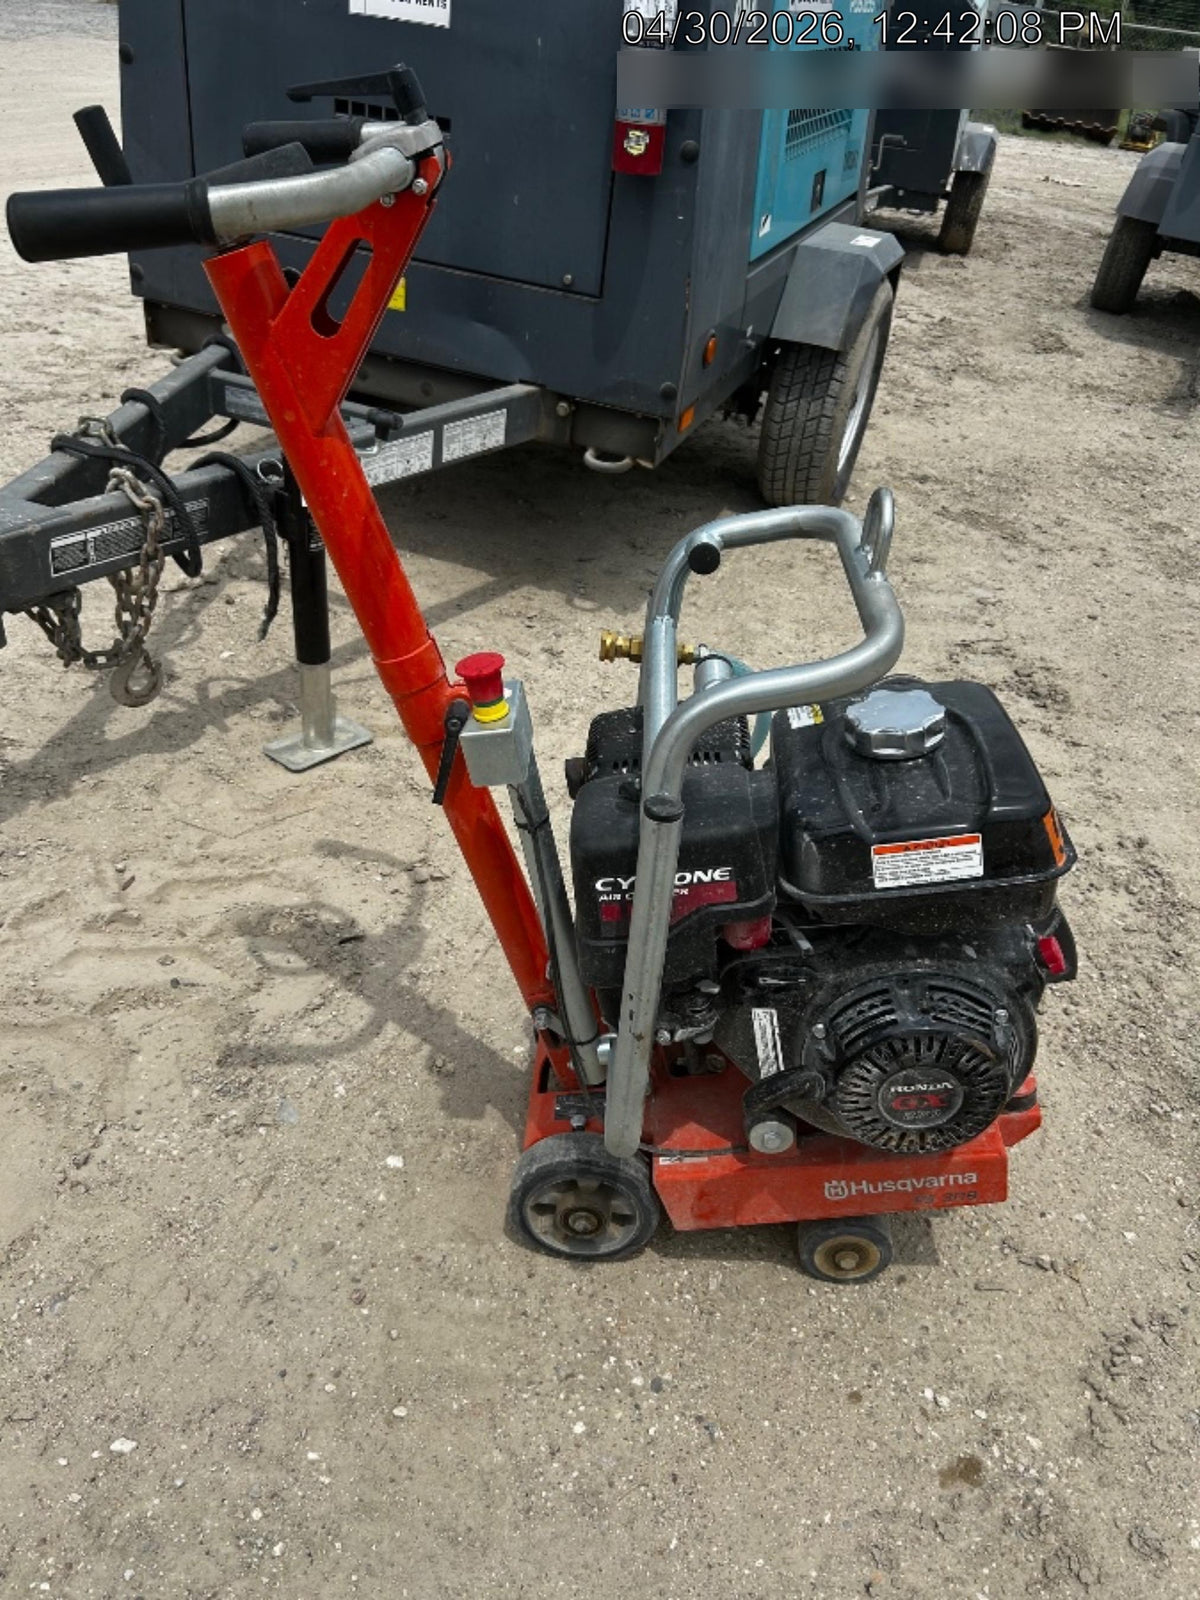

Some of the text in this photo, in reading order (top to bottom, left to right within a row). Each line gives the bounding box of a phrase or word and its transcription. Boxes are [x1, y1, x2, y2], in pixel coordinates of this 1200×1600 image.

[596, 867, 733, 891] CYONE
[890, 1081, 954, 1093] HONDA
[851, 1172, 978, 1197] Husqvarna
